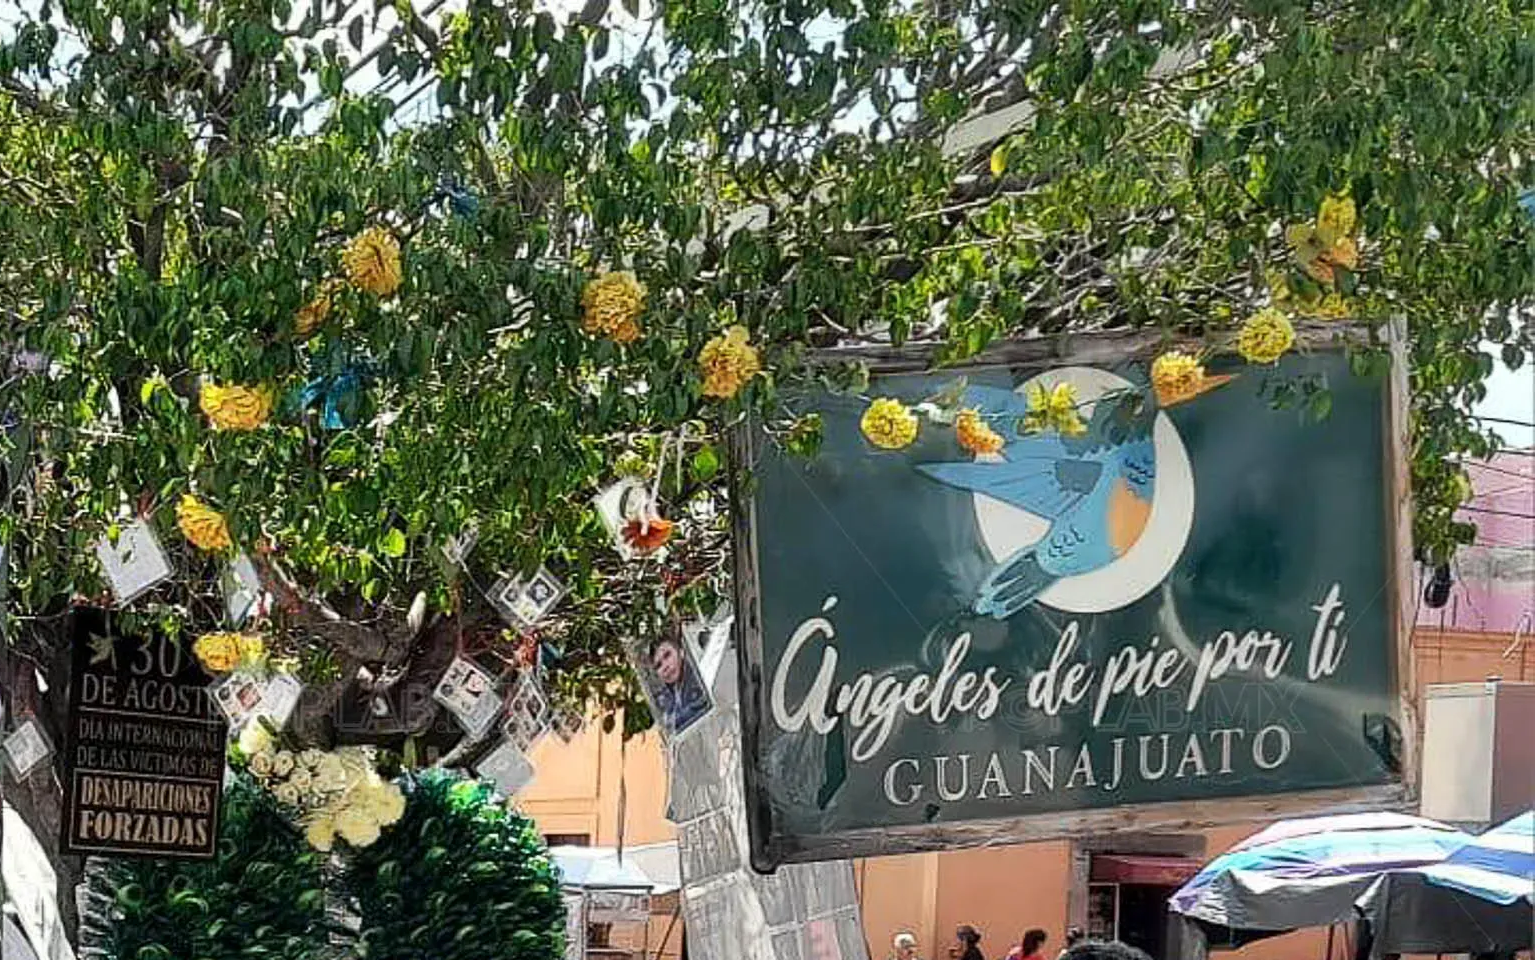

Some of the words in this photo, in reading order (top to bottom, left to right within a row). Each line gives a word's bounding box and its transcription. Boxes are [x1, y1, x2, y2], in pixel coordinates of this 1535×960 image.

[130, 630, 182, 678] 30
[82, 673, 116, 705] DE
[770, 597, 1012, 763] Ángeles
[1027, 621, 1095, 718] de
[1093, 636, 1190, 726] pie
[1186, 630, 1293, 712] por
[76, 745, 98, 767] DE
[100, 748, 127, 769] LAS
[883, 723, 1293, 806] GUANAJUATO
[81, 776, 211, 814] DESAPARICIONES
[78, 810, 208, 847] FORZADAS
